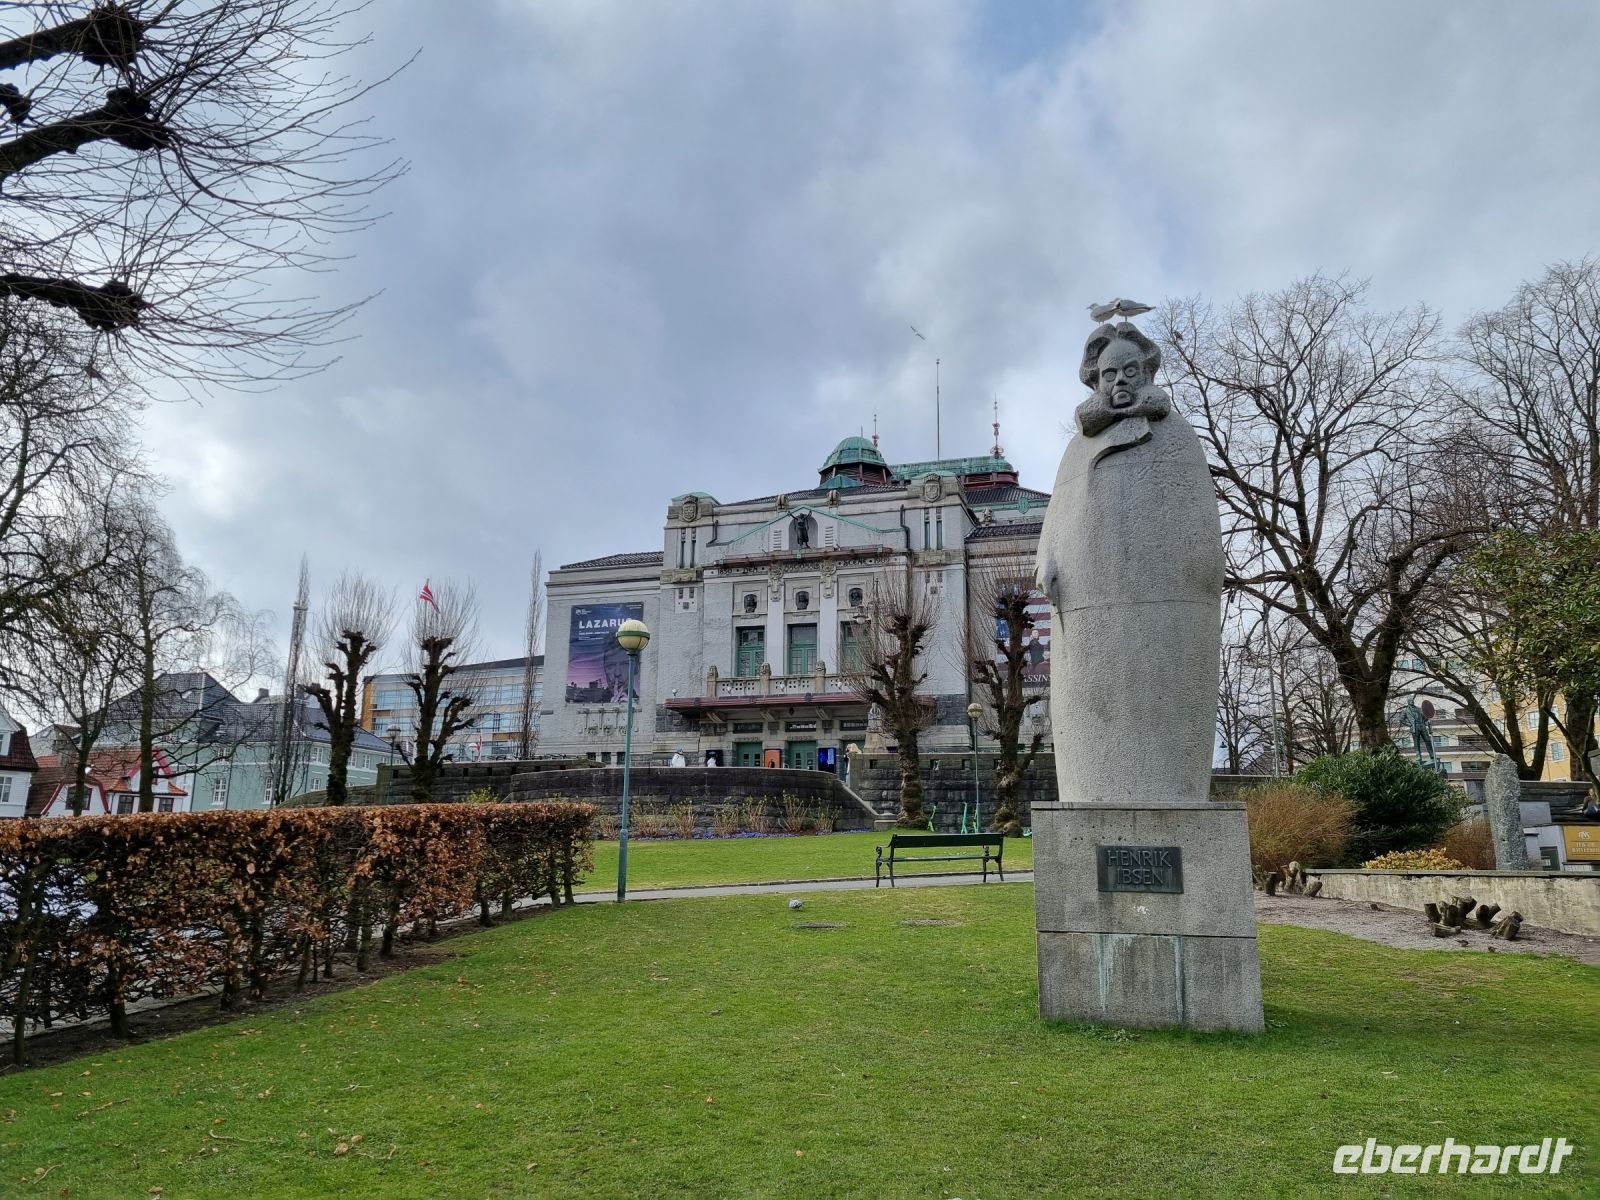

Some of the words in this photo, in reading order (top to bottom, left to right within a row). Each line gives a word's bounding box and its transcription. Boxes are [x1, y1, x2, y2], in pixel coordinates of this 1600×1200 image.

[578, 618, 633, 629] LAZARU
[1107, 850, 1172, 867] HENRIK
[1117, 868, 1164, 885] IBSEN
